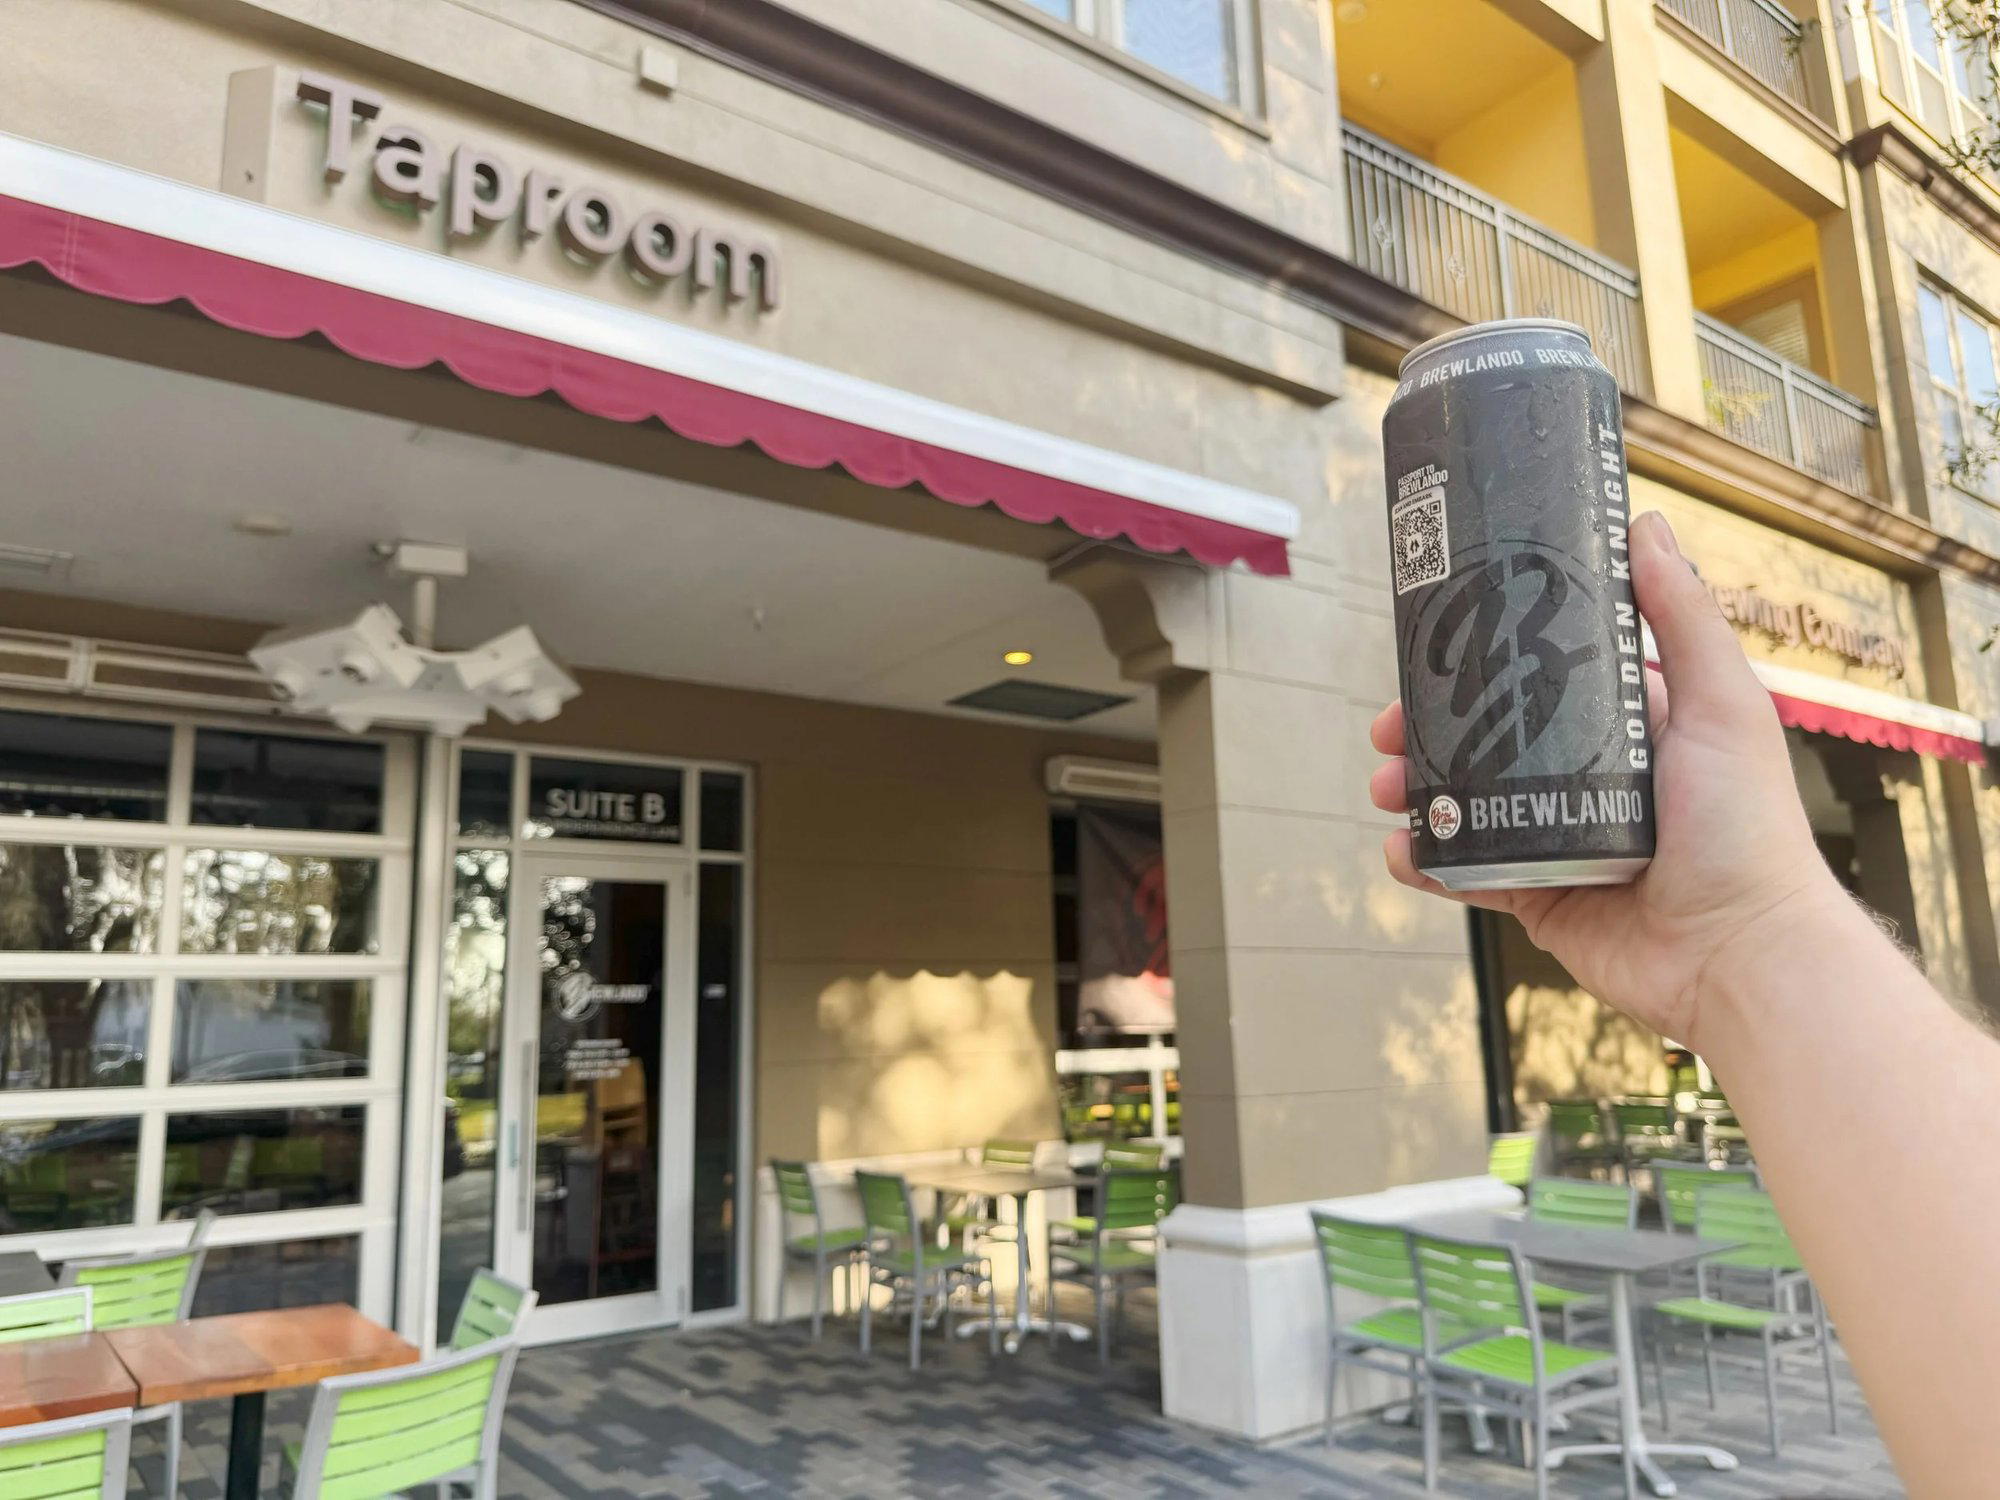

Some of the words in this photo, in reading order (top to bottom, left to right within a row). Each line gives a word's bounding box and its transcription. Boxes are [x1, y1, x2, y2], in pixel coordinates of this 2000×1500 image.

[297, 70, 780, 310] Taproom
[1420, 349, 1524, 387] BREWLANDO
[1398, 469, 1448, 500] BREWLANDO
[1598, 422, 1631, 581] KNIGHT
[1713, 584, 1801, 650] ewing
[1801, 603, 1906, 682] Company
[1614, 601, 1649, 770] GOLDEN
[545, 787, 637, 822] SUITE
[641, 792, 667, 824] B
[1469, 789, 1644, 831] BREWLANDO
